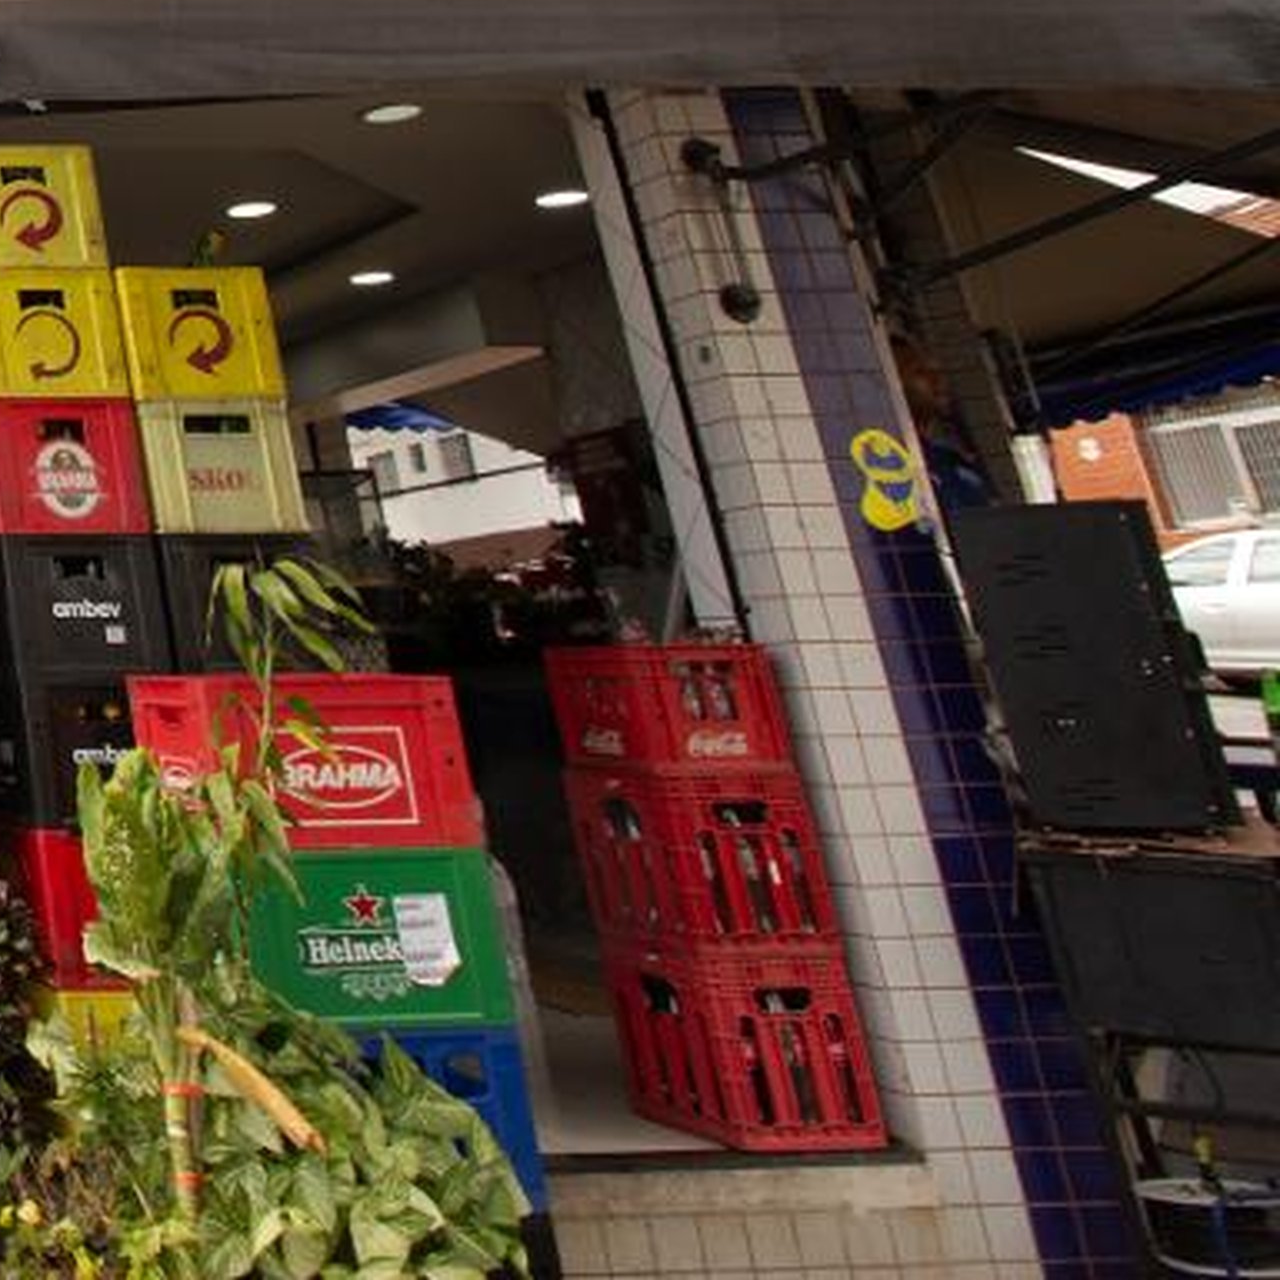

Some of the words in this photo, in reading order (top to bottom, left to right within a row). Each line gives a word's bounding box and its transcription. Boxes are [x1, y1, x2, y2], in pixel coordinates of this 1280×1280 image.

[52, 598, 122, 618] ambev
[73, 744, 131, 764] ambe
[307, 934, 407, 965] Heinek
